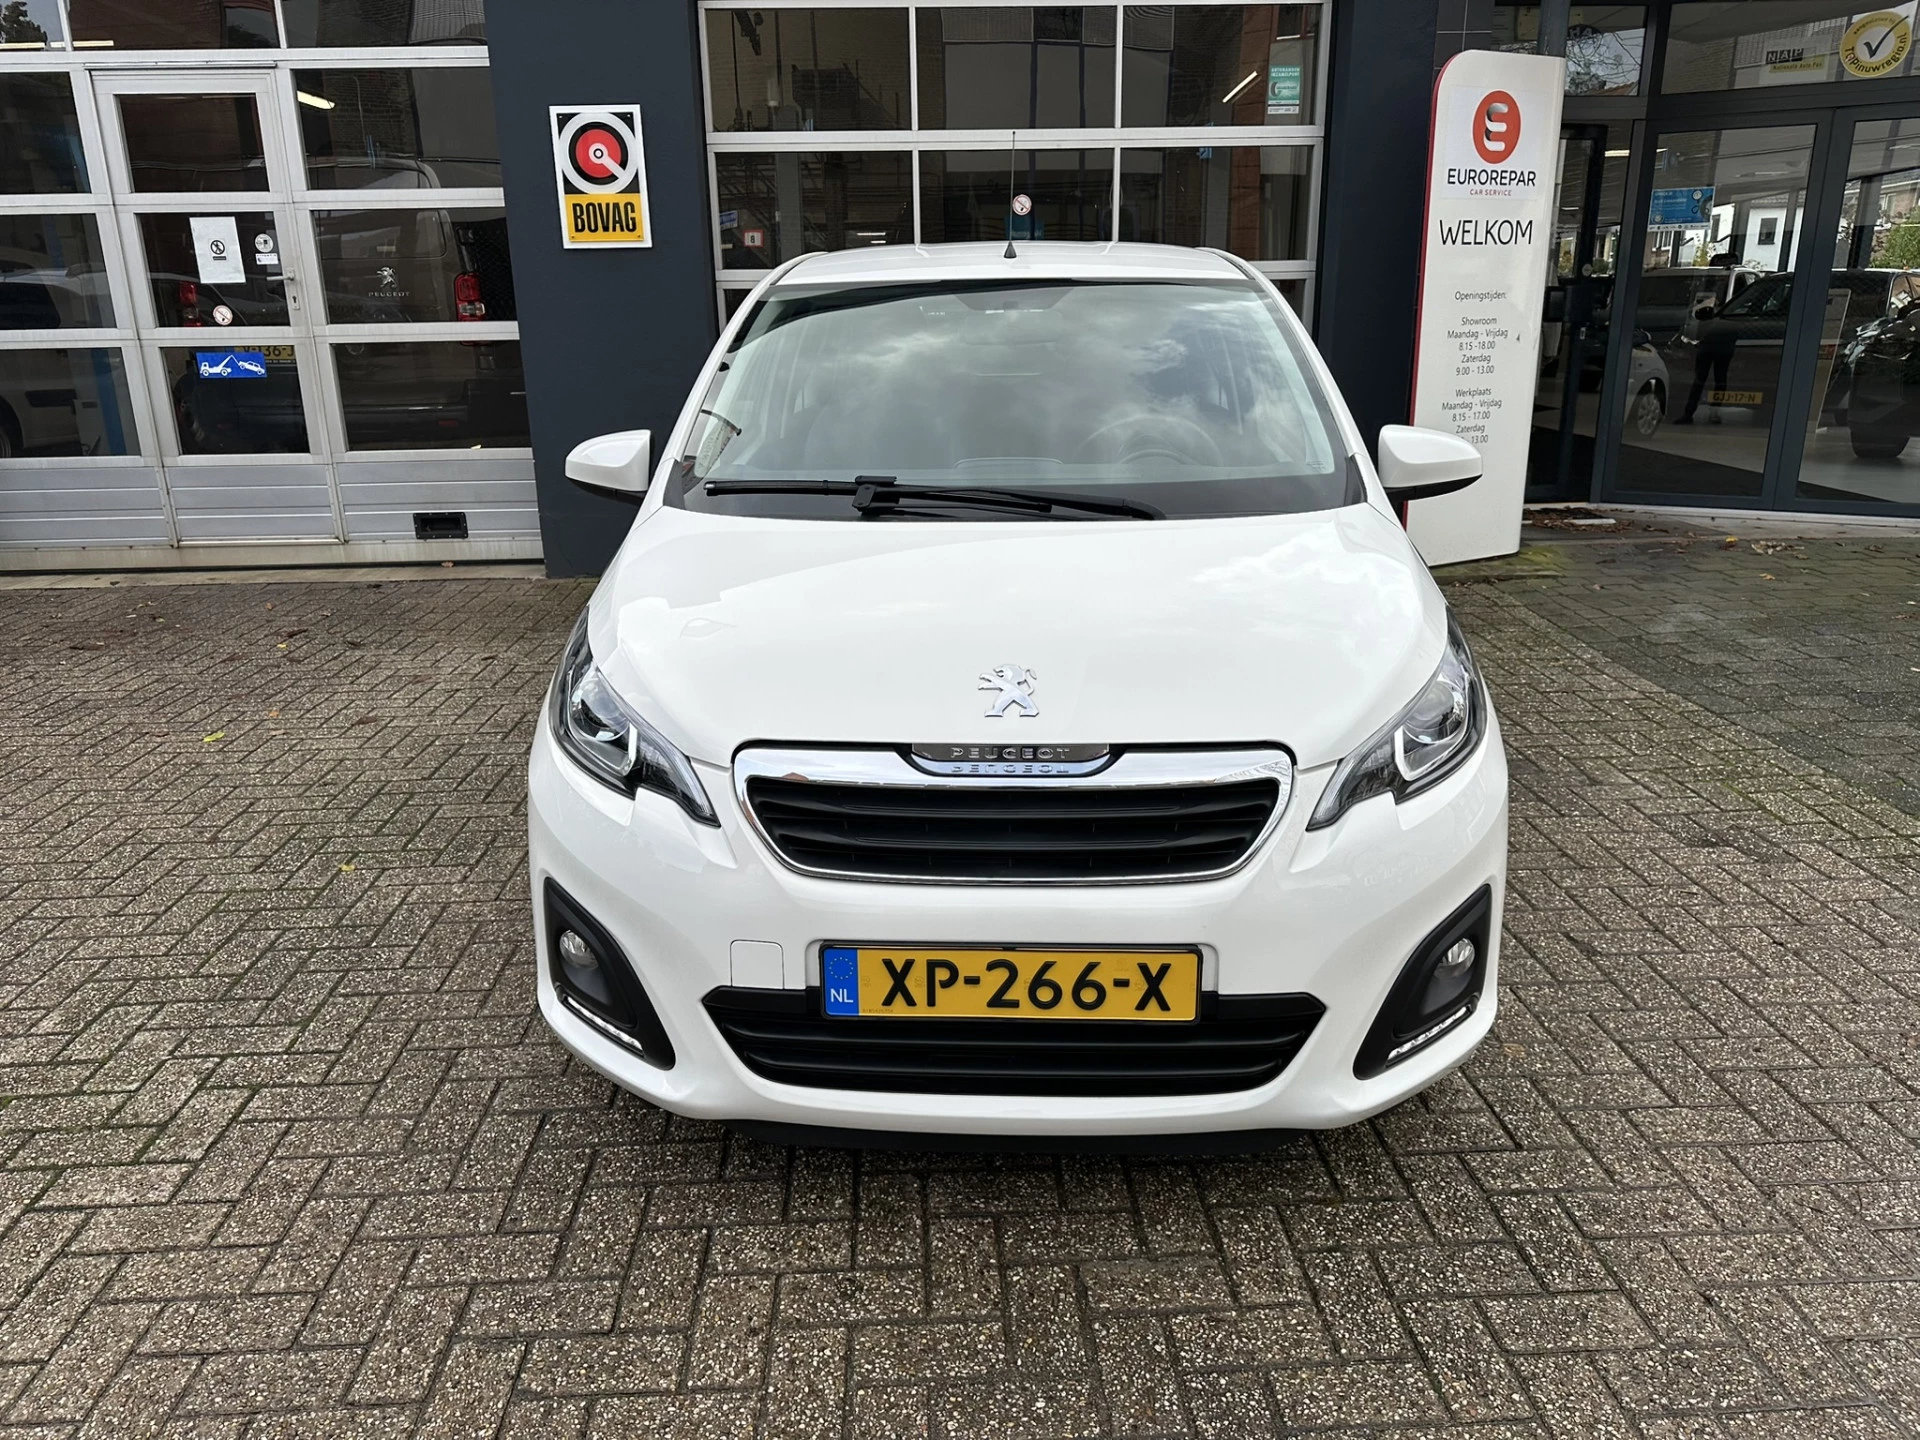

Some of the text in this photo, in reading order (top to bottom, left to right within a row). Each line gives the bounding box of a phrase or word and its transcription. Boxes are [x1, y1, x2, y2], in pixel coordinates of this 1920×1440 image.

[1767, 48, 1803, 63] NAP
[1447, 168, 1536, 187] EUROREPAR
[1470, 188, 1512, 197] CAR SERVICE
[572, 202, 637, 233] BOVAG
[1439, 219, 1534, 246] WELKOM
[1461, 316, 1497, 326] Showroom
[1447, 329, 1479, 340] Maandag
[1485, 328, 1508, 339] Vrijdag
[1459, 342, 1473, 351] 8.15
[1461, 353, 1491, 364] Zaterdag
[1456, 366, 1470, 376] 9.00
[1477, 365, 1495, 374] 13.00
[1456, 387, 1492, 398] Werkplaats
[1442, 401, 1473, 411] Maandag
[1479, 399, 1502, 409] Vrijdag
[1452, 412, 1466, 422] 8.15
[1473, 410, 1491, 420] 17.00
[1456, 424, 1485, 434] Zaterdag
[951, 747, 1070, 759] PEUGEOT
[881, 957, 1172, 1012] XP-266-X
[830, 988, 854, 1003] NL
